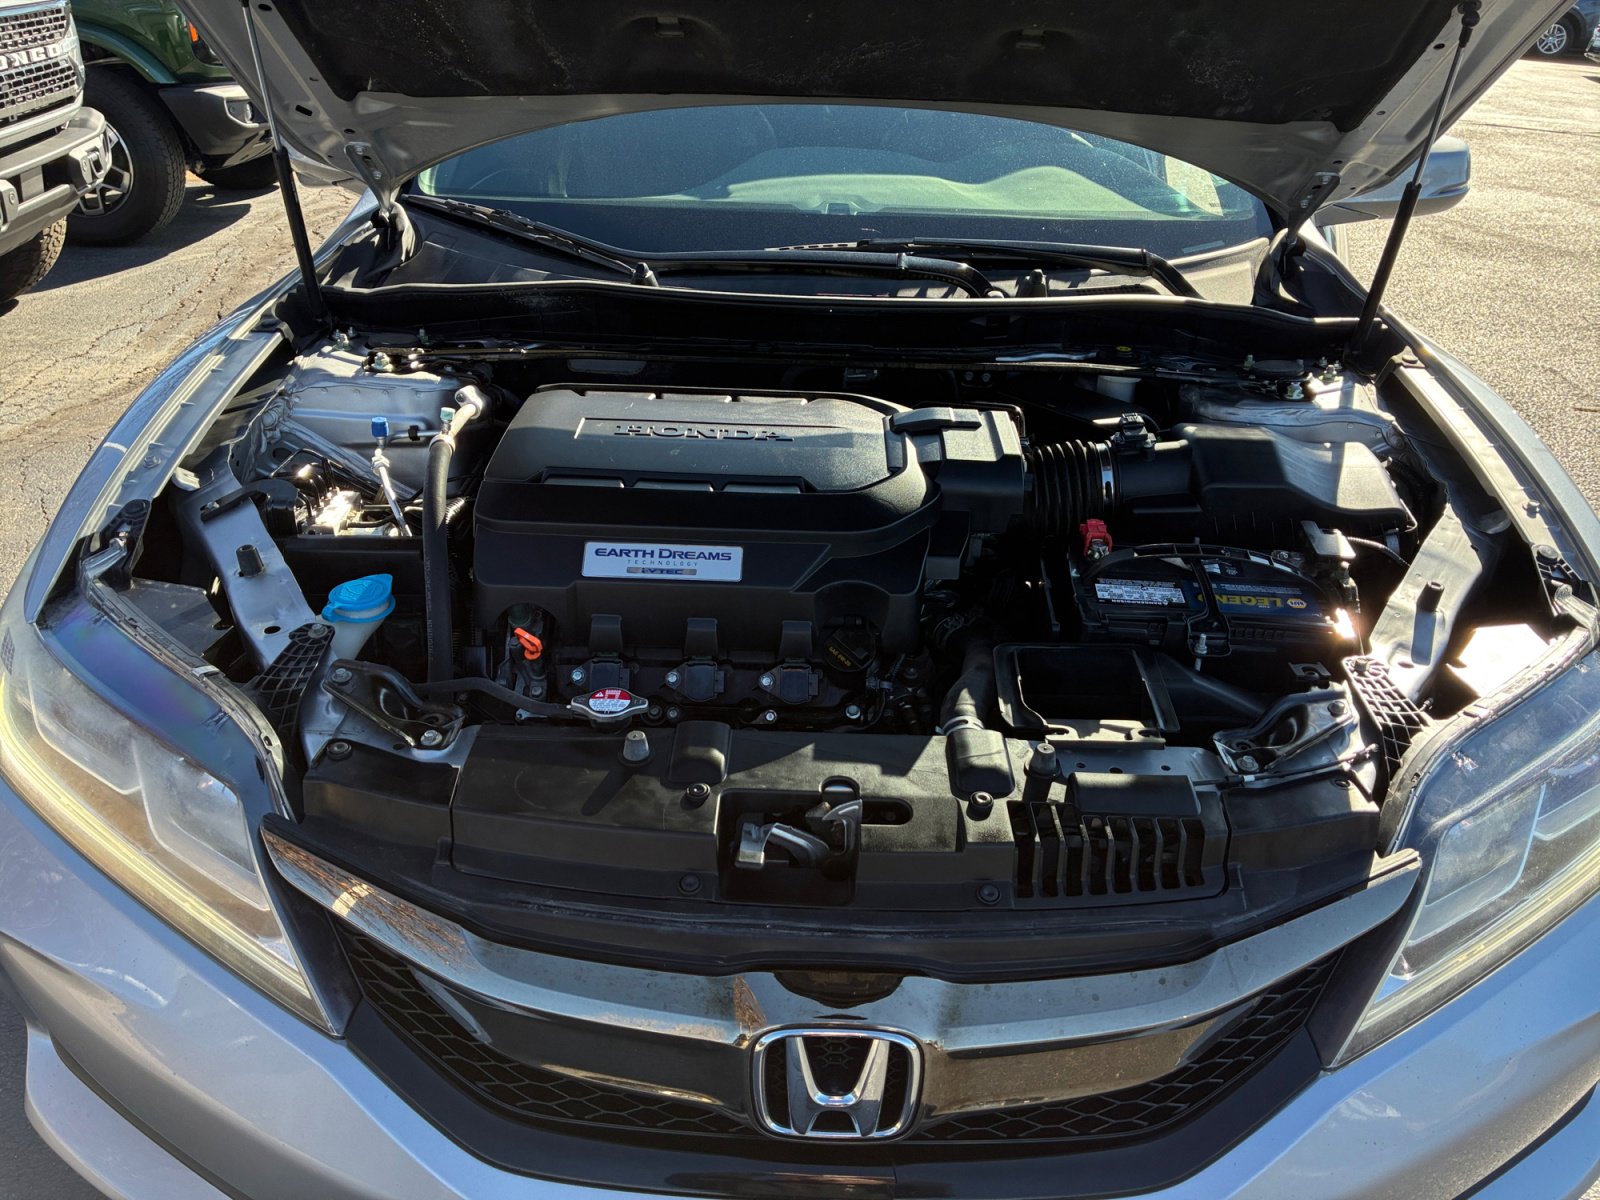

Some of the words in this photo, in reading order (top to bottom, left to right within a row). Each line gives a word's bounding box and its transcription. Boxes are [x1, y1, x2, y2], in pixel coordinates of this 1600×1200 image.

[613, 424, 794, 442] HONDA
[594, 548, 654, 560] EARTH
[658, 548, 732, 561] DREAMS
[627, 559, 698, 567] TECHNOLOGY
